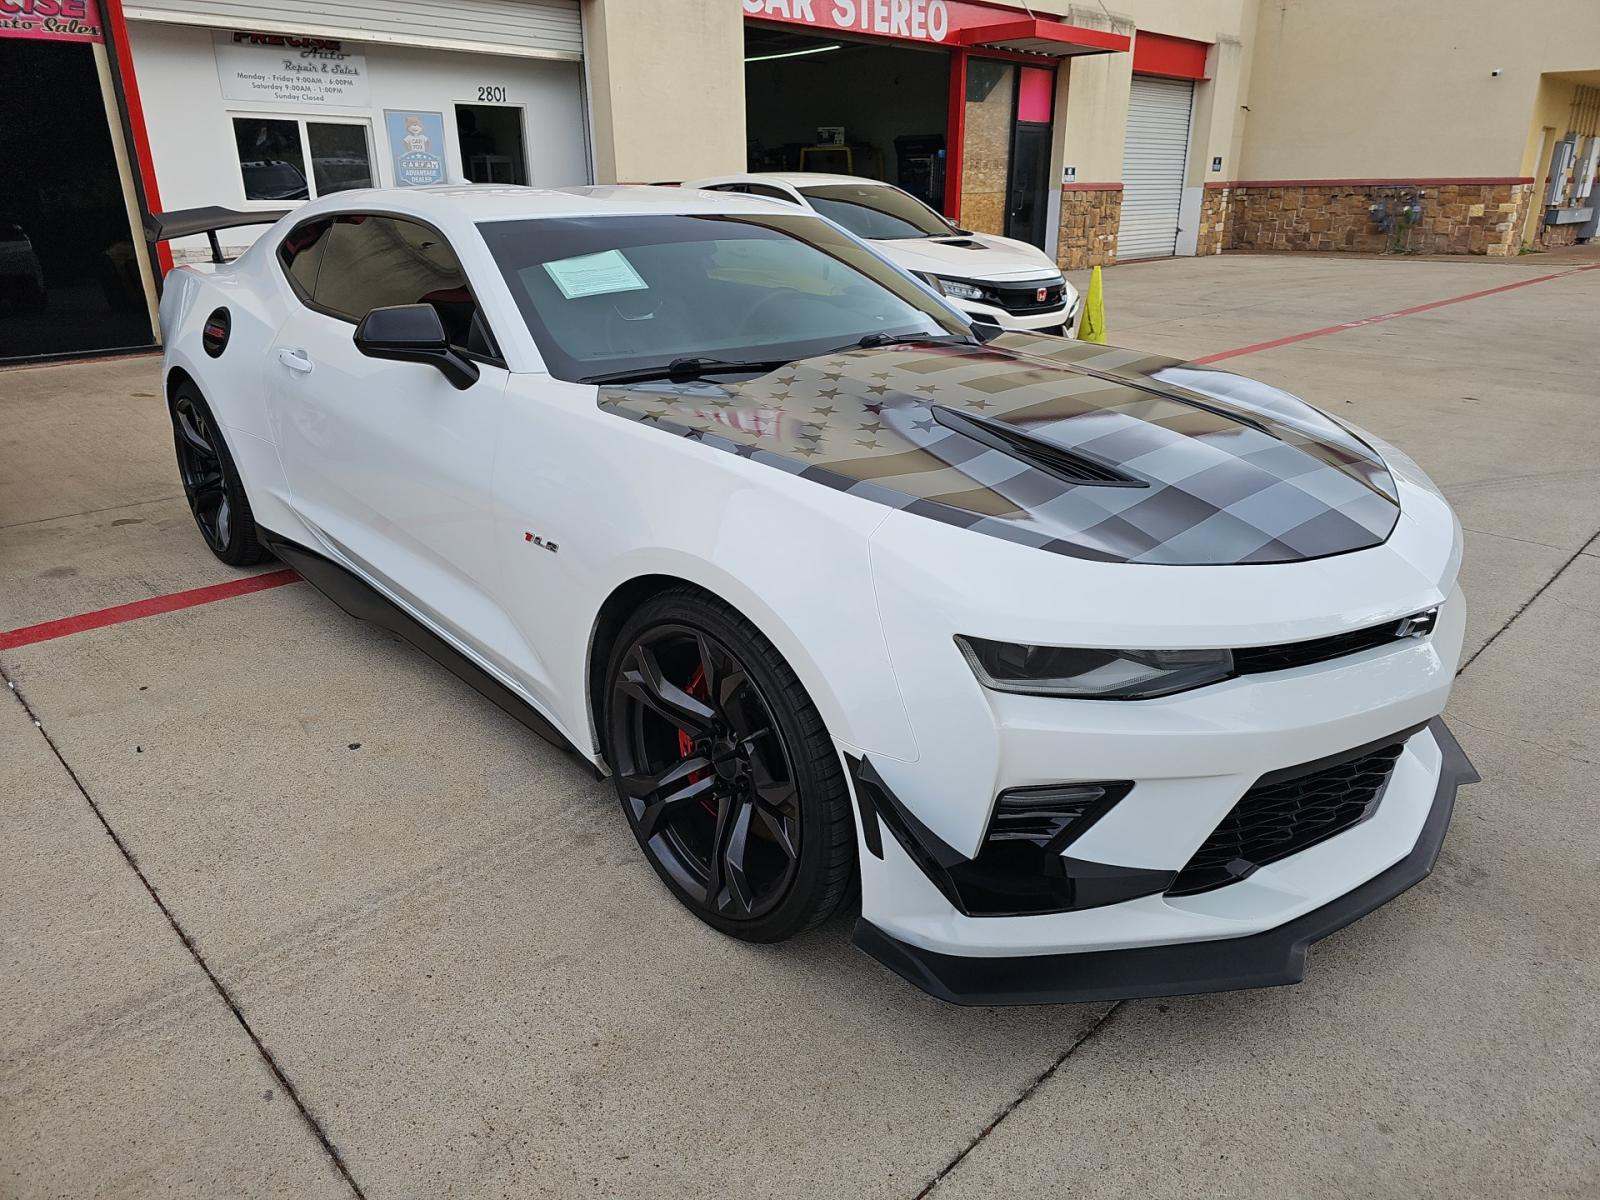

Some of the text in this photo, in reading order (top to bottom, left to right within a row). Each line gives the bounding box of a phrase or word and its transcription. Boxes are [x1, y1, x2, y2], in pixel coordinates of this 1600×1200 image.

[42, 18, 99, 35] Sales
[831, 0, 948, 42] STEREO
[300, 47, 350, 61] Auto
[282, 60, 360, 76] Repair & Sales
[237, 72, 266, 81] Monday
[272, 75, 294, 83] Friday
[296, 76, 323, 85] 9:00AM
[328, 78, 354, 87] 6:00PM
[251, 82, 283, 91] Saturday
[285, 84, 312, 93] 9:00AM
[318, 86, 344, 95] 1:00PM
[477, 86, 507, 102] 2801
[274, 93, 325, 102] Sunday Closed
